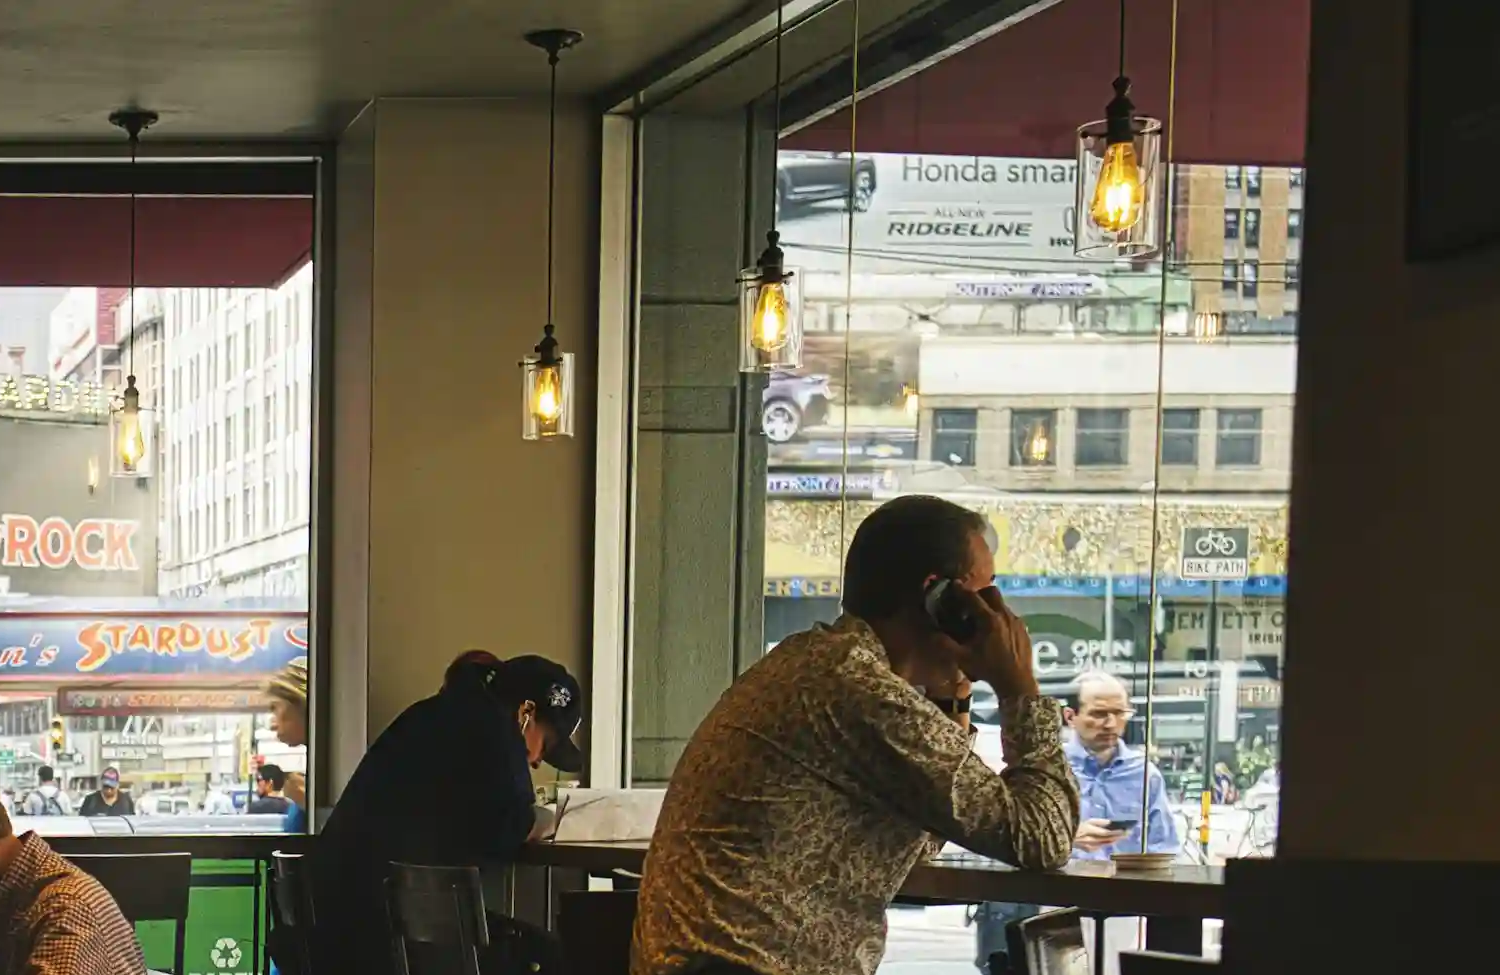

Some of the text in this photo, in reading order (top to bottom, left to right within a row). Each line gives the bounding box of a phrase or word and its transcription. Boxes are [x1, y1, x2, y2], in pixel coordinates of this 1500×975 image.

[903, 155, 1077, 184] Honda smar
[887, 221, 1033, 238] RIDGELINE
[2, 514, 141, 571] ROCK
[1215, 562, 1245, 574] PATH
[1177, 611, 1261, 630] EMETT
[75, 618, 274, 672] STARDUST
